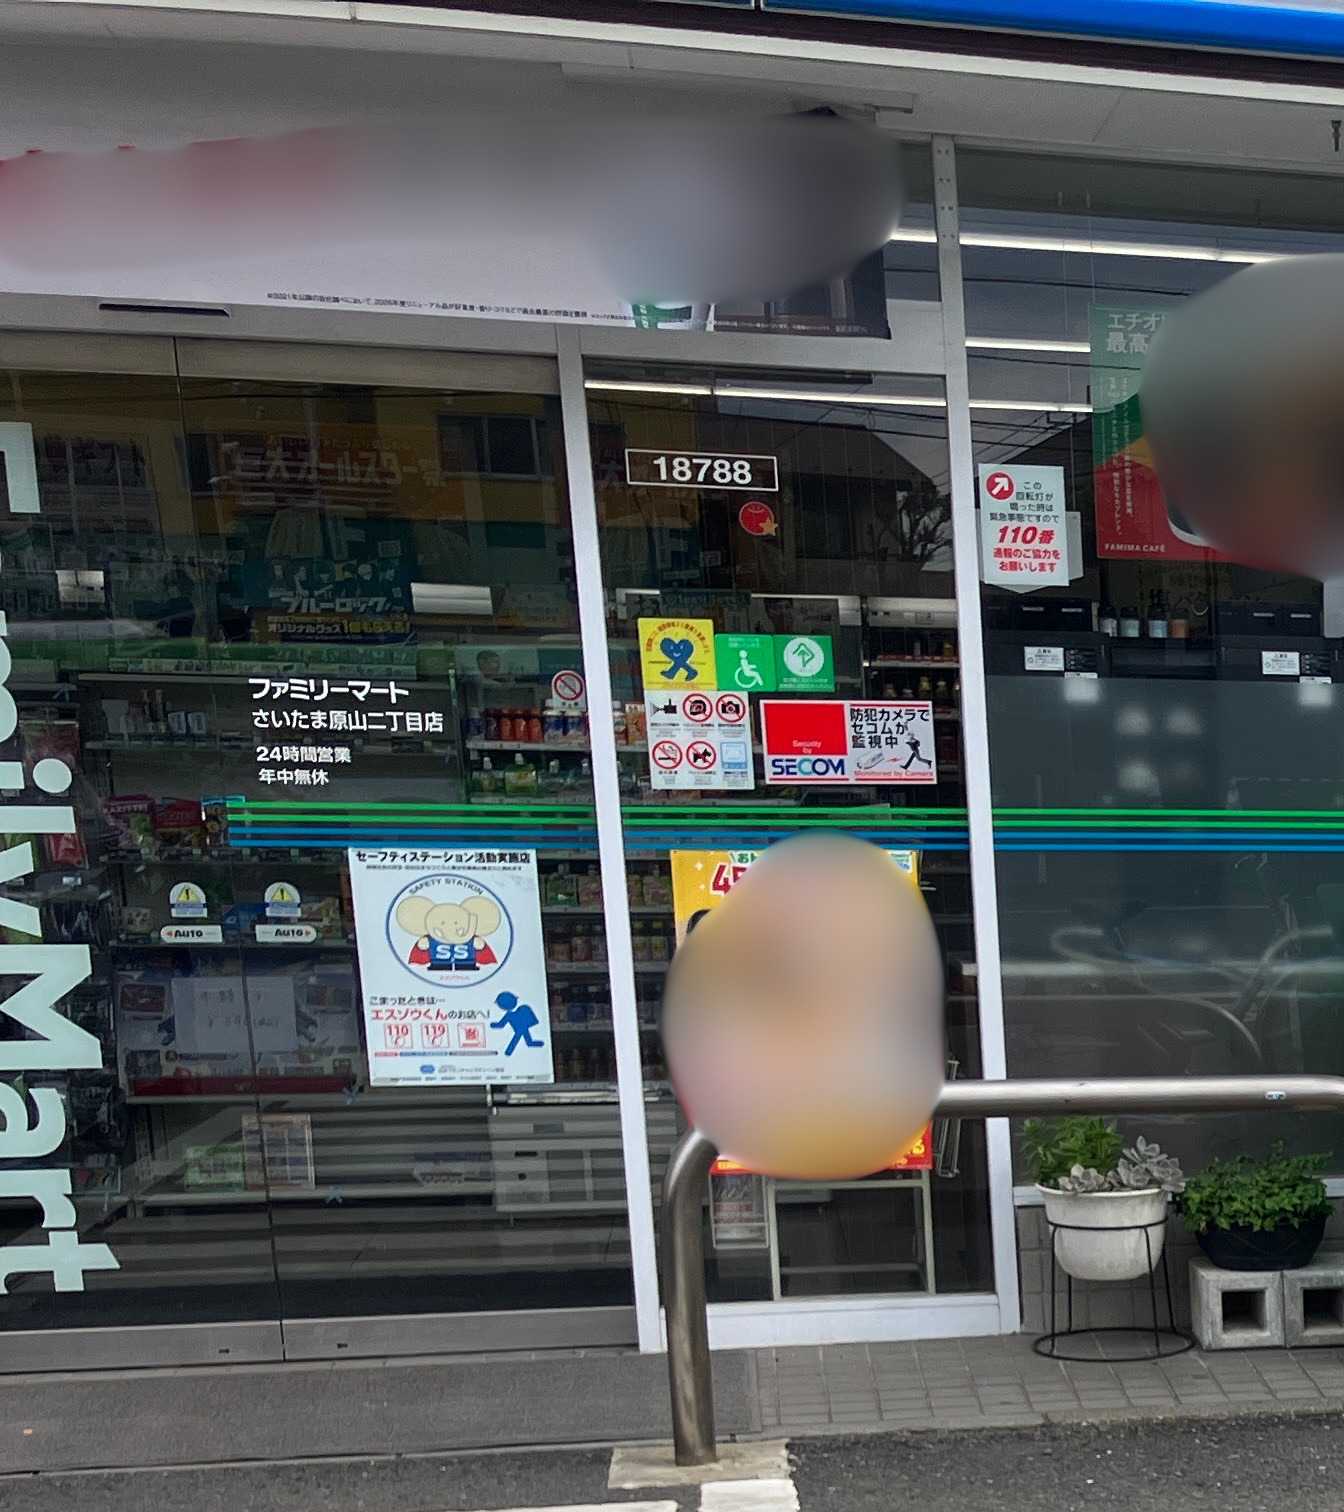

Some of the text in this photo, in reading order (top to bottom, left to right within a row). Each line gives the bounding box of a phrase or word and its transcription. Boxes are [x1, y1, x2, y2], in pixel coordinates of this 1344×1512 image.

[1107, 312, 1165, 332] エチオ
[653, 456, 752, 485] 18788
[1024, 481, 1042, 490] この
[998, 525, 1055, 544] 110番
[999, 561, 1057, 572] お願いします
[248, 678, 409, 704] ファミリーマート
[251, 708, 444, 733] さいたま原山二丁目店
[850, 708, 930, 722] 防犯カメラで
[852, 735, 898, 749] 監視中
[256, 746, 352, 763] 24時間営業
[771, 758, 845, 776] SECOM
[258, 768, 330, 785] 年中無休
[355, 851, 531, 864] セーフティステーション活動実施店
[408, 878, 443, 894] SAFETY
[436, 944, 469, 961] SS
[387, 1023, 446, 1036] 110 119
